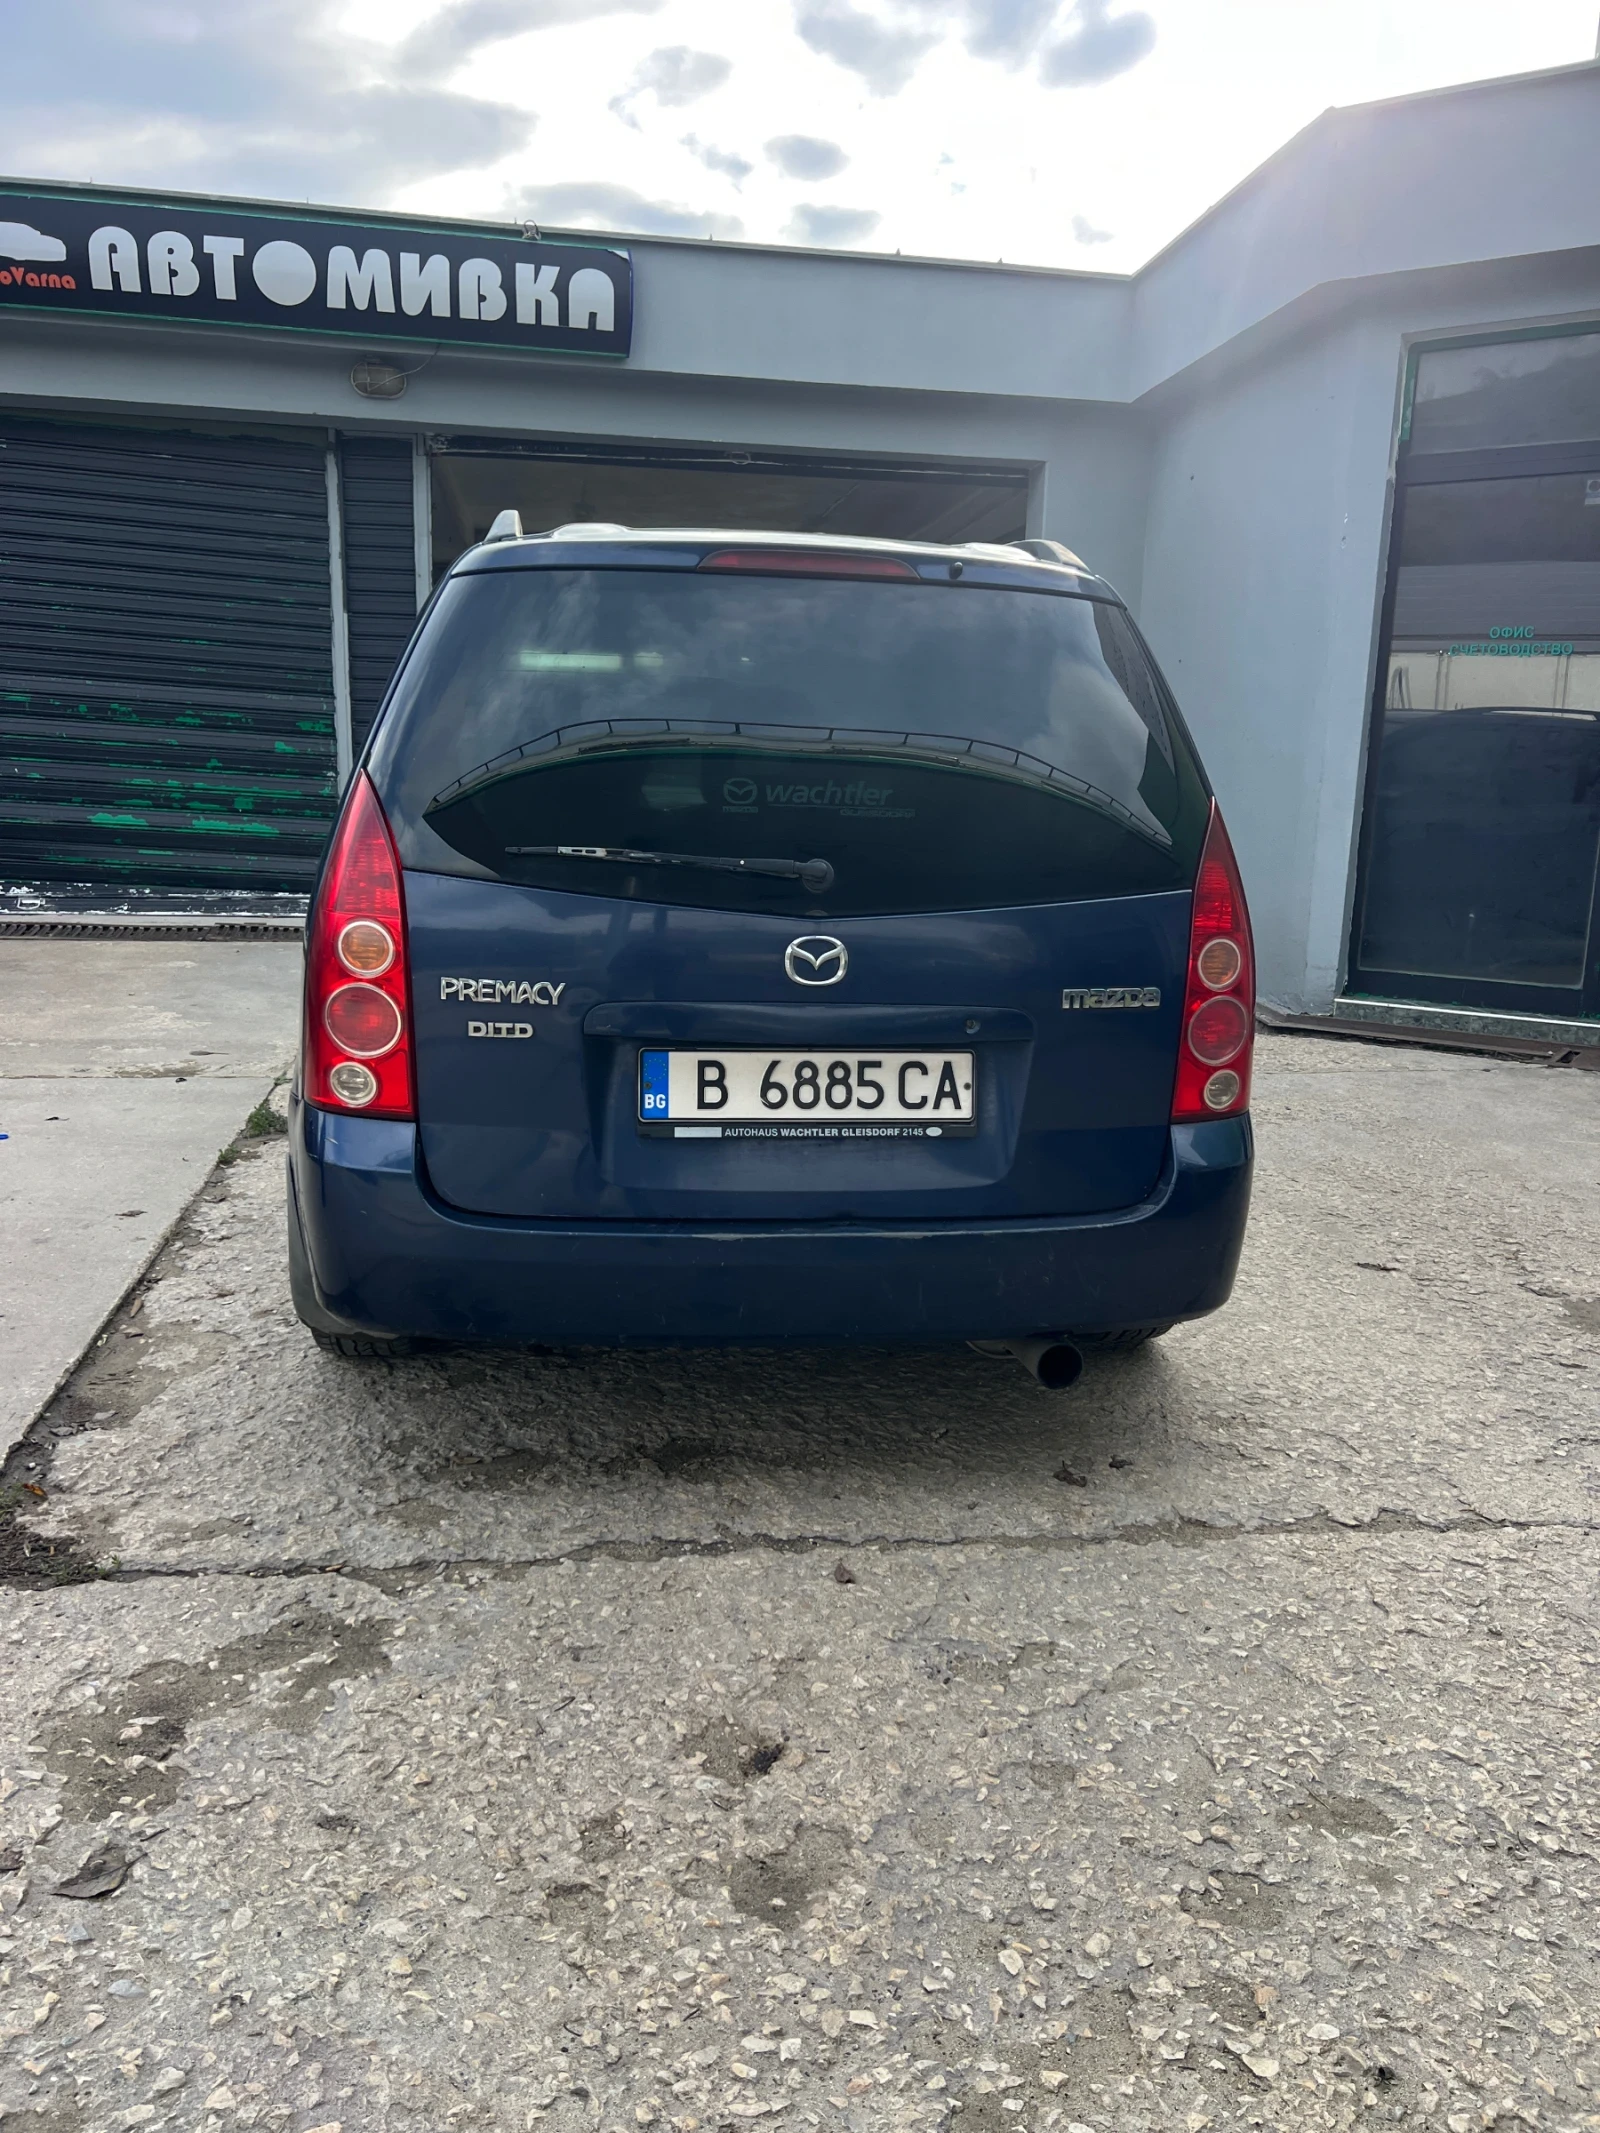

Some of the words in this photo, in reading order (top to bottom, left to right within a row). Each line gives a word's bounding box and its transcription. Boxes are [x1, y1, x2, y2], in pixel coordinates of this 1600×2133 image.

[88, 225, 616, 333] АВТОМИВКА
[1489, 625, 1535, 639] ОФИС
[1449, 643, 1574, 657] СЧЕТОВОДСТВО
[765, 779, 894, 806] wachtler
[440, 976, 567, 1006] PREMACY
[1062, 987, 1161, 1009] mazda
[467, 1021, 534, 1038] DITD
[696, 1059, 729, 1110] B
[644, 1094, 666, 1109] BG
[724, 1127, 779, 1138] AUTOHAUS
[780, 1127, 839, 1138] WACHTLER
[841, 1127, 901, 1138] GLEISDORF
[902, 1127, 924, 1138] 2145
